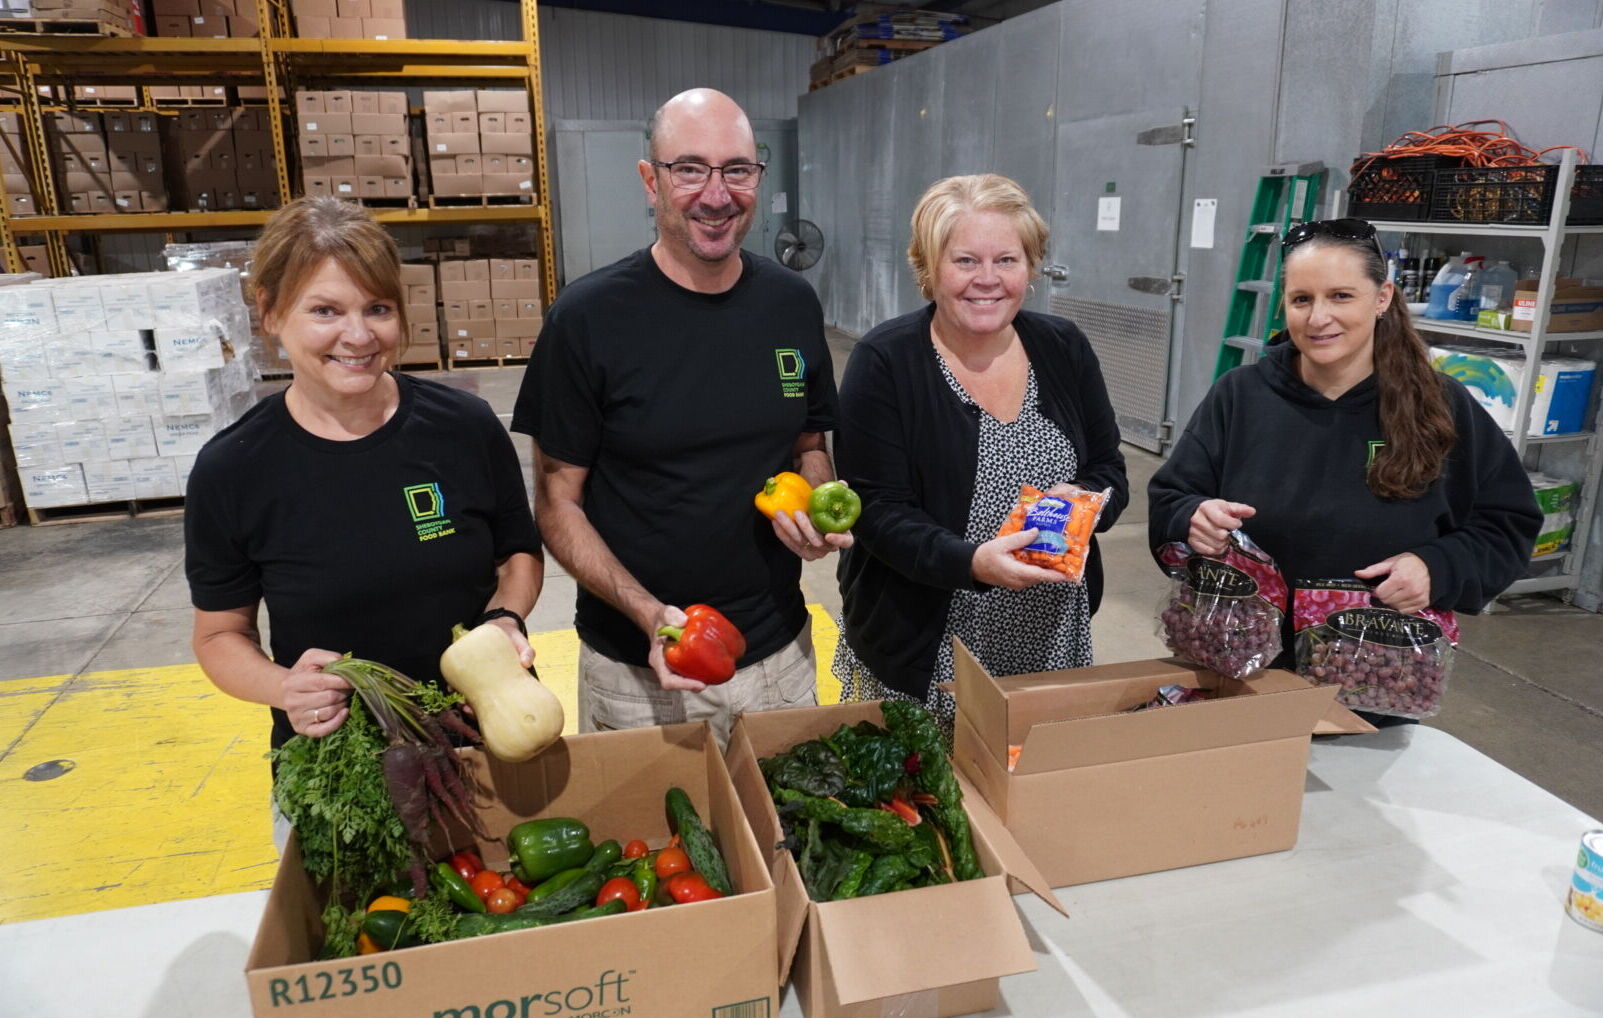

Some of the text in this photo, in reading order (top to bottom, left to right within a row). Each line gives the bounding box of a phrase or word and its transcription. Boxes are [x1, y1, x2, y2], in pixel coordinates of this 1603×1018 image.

[418, 526, 443, 535] COUNTY
[420, 528, 455, 541] FOOD BANK
[1344, 612, 1424, 634] BRAVANTE
[269, 961, 402, 1007] R12350
